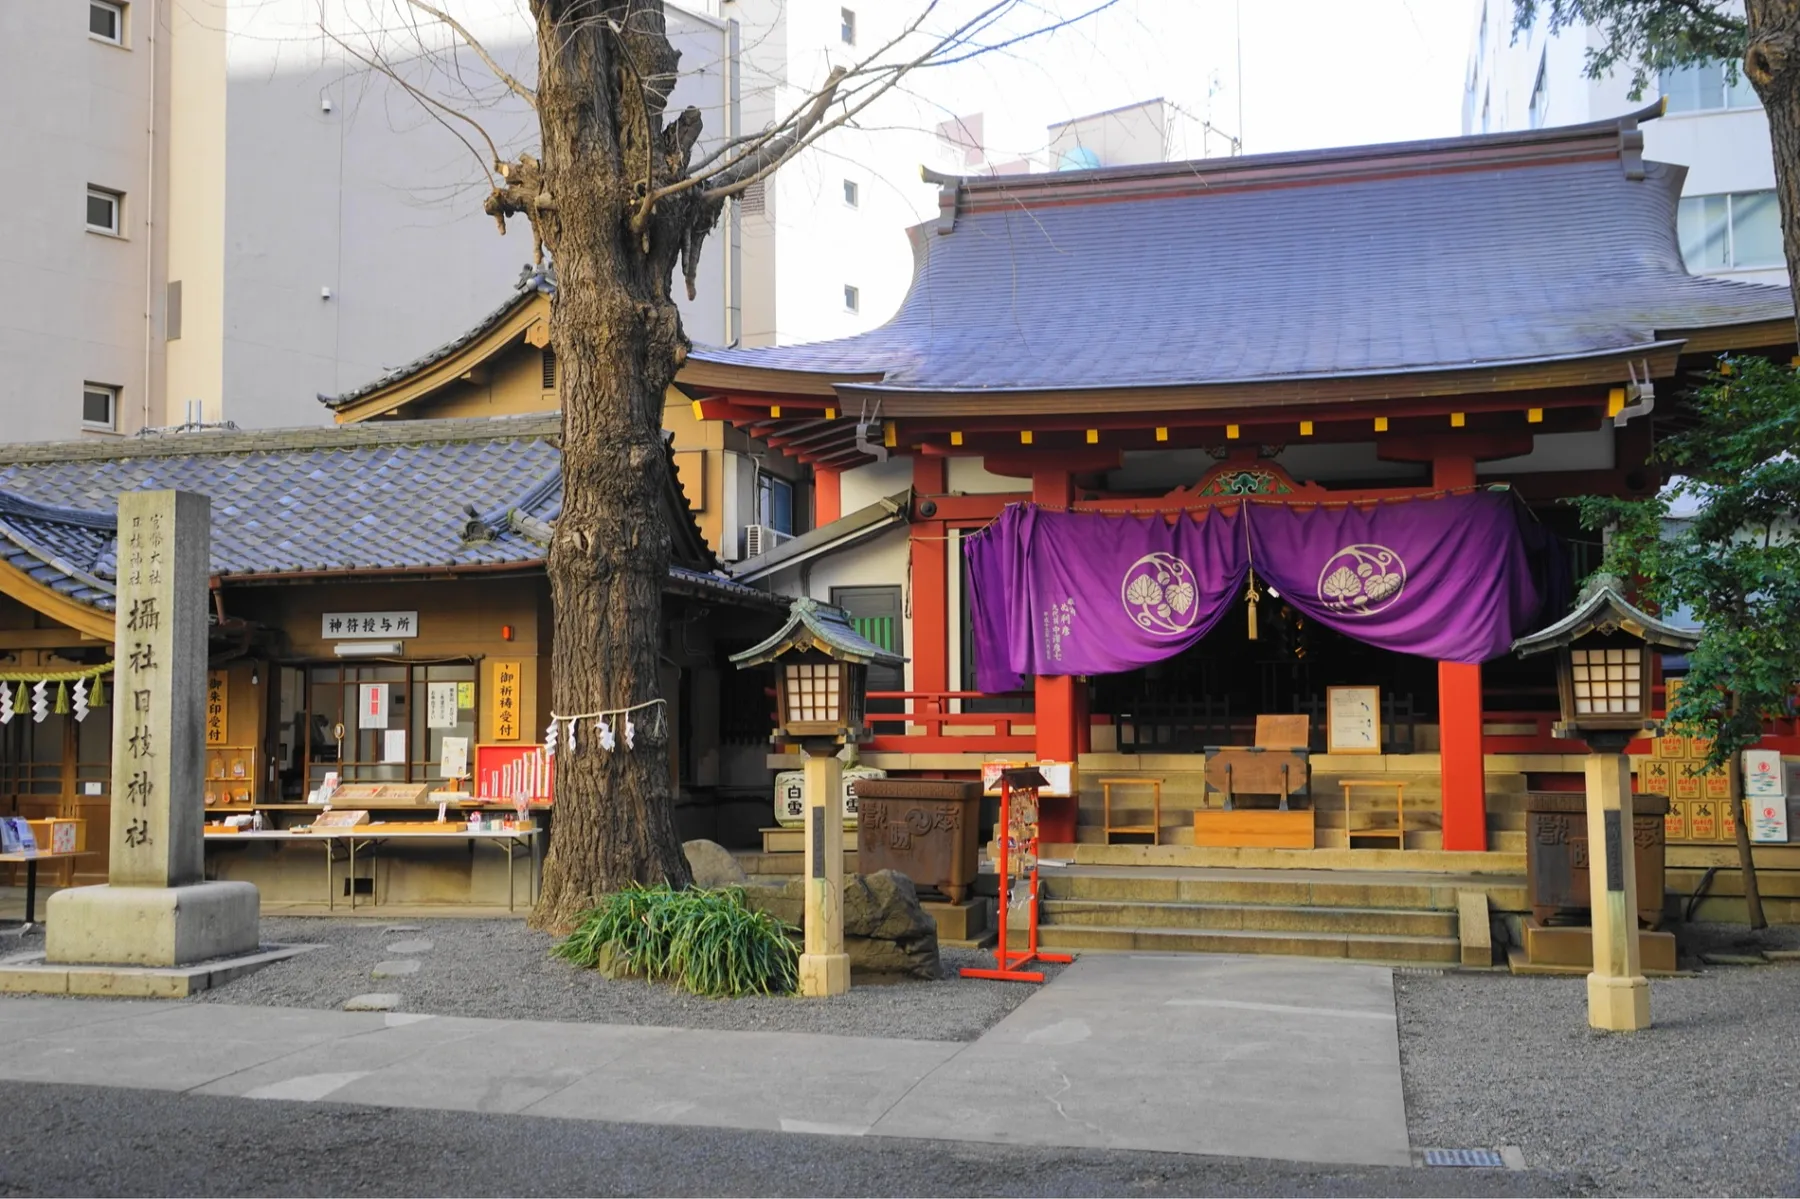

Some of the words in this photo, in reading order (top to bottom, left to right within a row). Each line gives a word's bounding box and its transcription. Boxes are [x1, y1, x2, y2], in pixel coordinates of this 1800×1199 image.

[329, 616, 410, 633] 神符授与所
[125, 597, 160, 848] 攝社日枝神社
[208, 677, 222, 741] 御朱印受付
[499, 671, 514, 737] 御祈祷受付
[787, 785, 803, 816] 白雪
